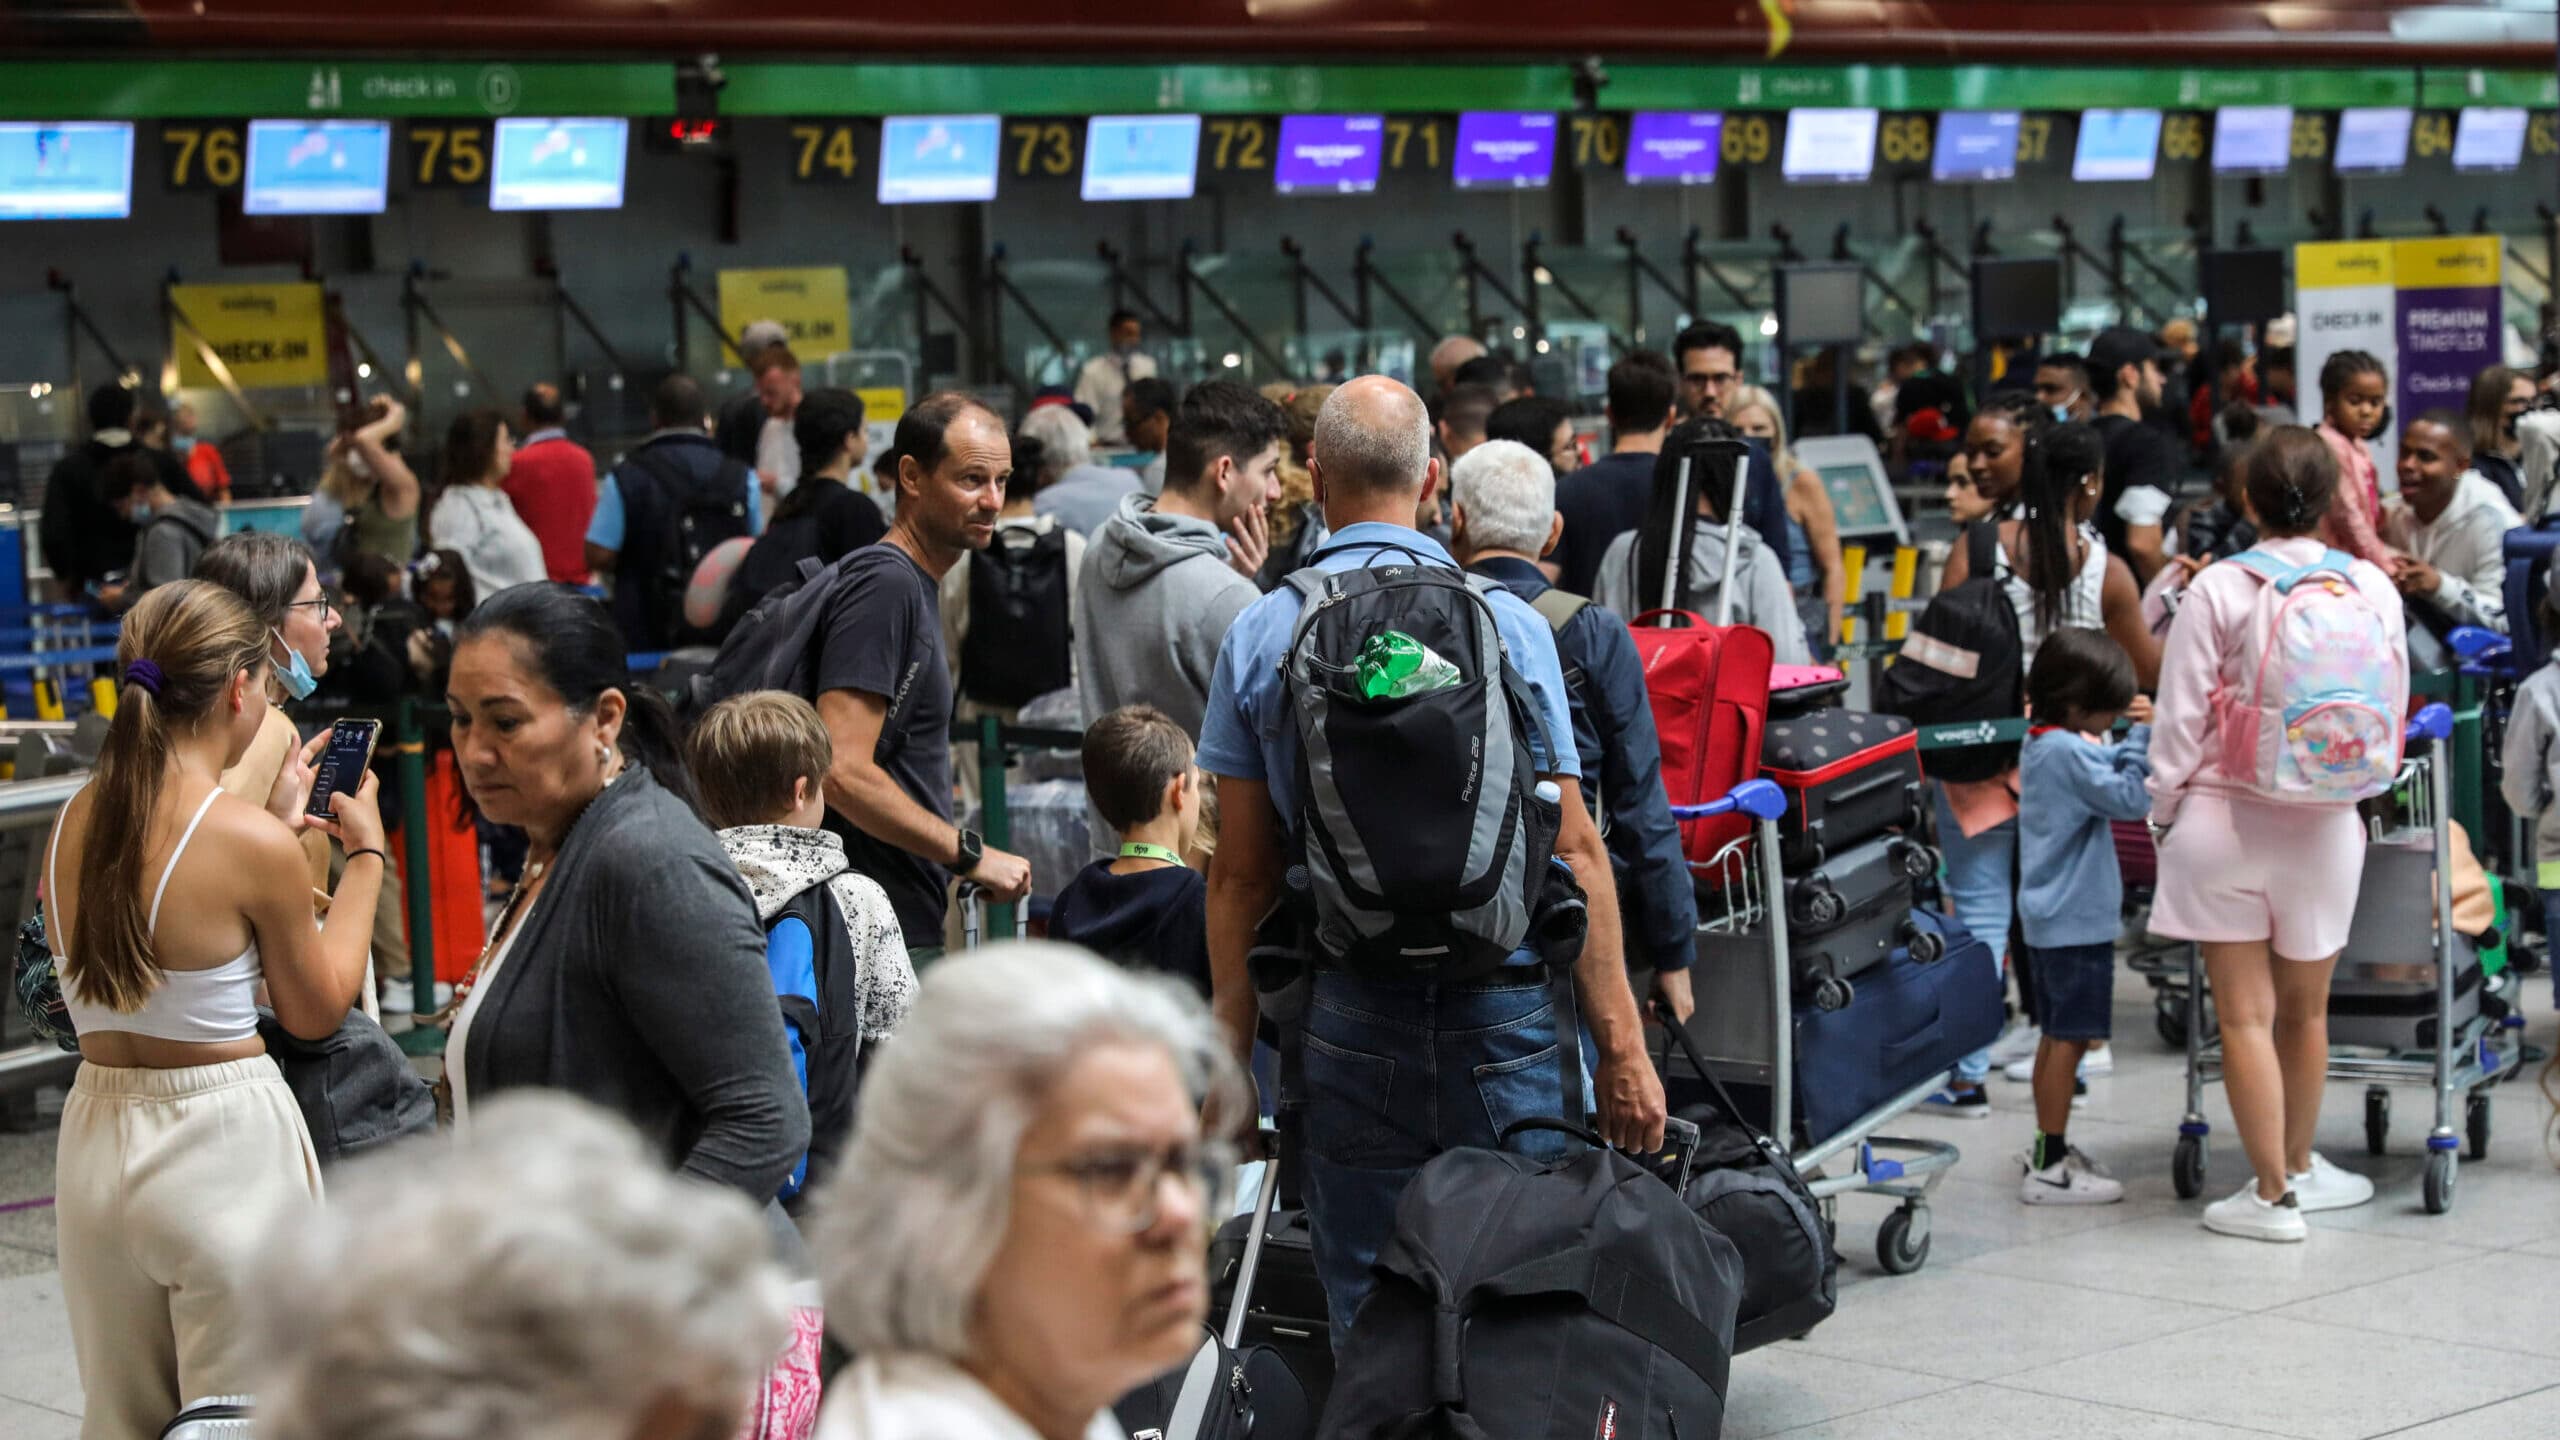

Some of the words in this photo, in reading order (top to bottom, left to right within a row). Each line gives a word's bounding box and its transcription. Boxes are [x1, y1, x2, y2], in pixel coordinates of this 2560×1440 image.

[363, 77, 430, 99] check
[434, 77, 456, 98] in
[164, 129, 241, 186] 76
[411, 129, 485, 183] 75
[792, 126, 858, 178] 74
[1010, 124, 1073, 175] 73
[1209, 121, 1266, 169] 72
[1387, 121, 1440, 169] 71
[1571, 117, 1620, 164] 70
[1721, 116, 1770, 163] 69
[1881, 116, 1930, 162] 68
[2163, 115, 2202, 159] 66
[2414, 114, 2451, 156] 64
[2407, 308, 2488, 330] PREMIUM
[2408, 331, 2487, 352] TIMEFLEX
[887, 661, 920, 720] DAKINE
[1461, 760, 1478, 802] Airlite
[1471, 735, 1480, 758] 28
